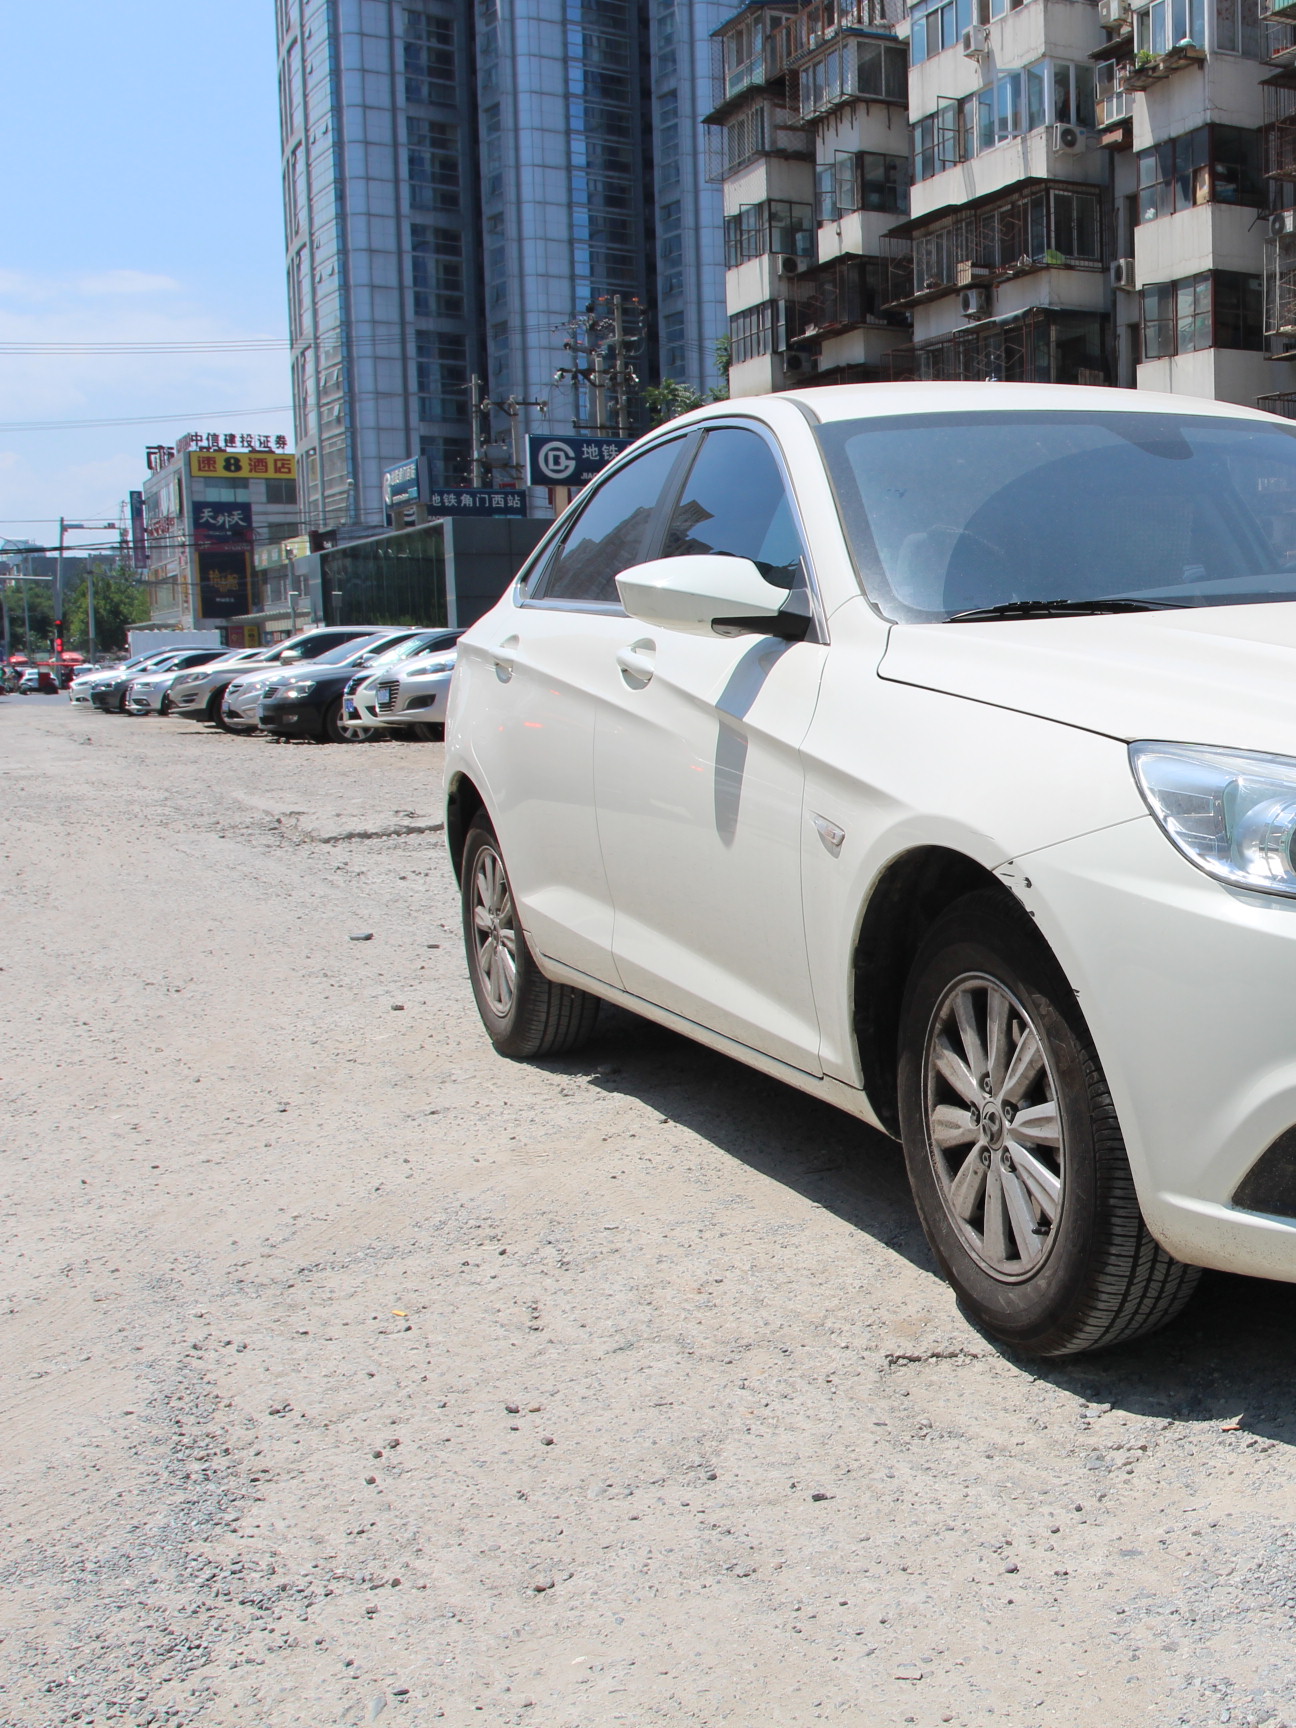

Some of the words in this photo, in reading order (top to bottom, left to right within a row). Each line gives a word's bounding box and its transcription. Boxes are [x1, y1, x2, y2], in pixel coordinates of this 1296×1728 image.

[190, 432, 288, 449] 中信建投证券
[581, 443, 629, 461] 地铁
[197, 455, 293, 475] 速8酒店
[199, 507, 248, 529] 天外天
